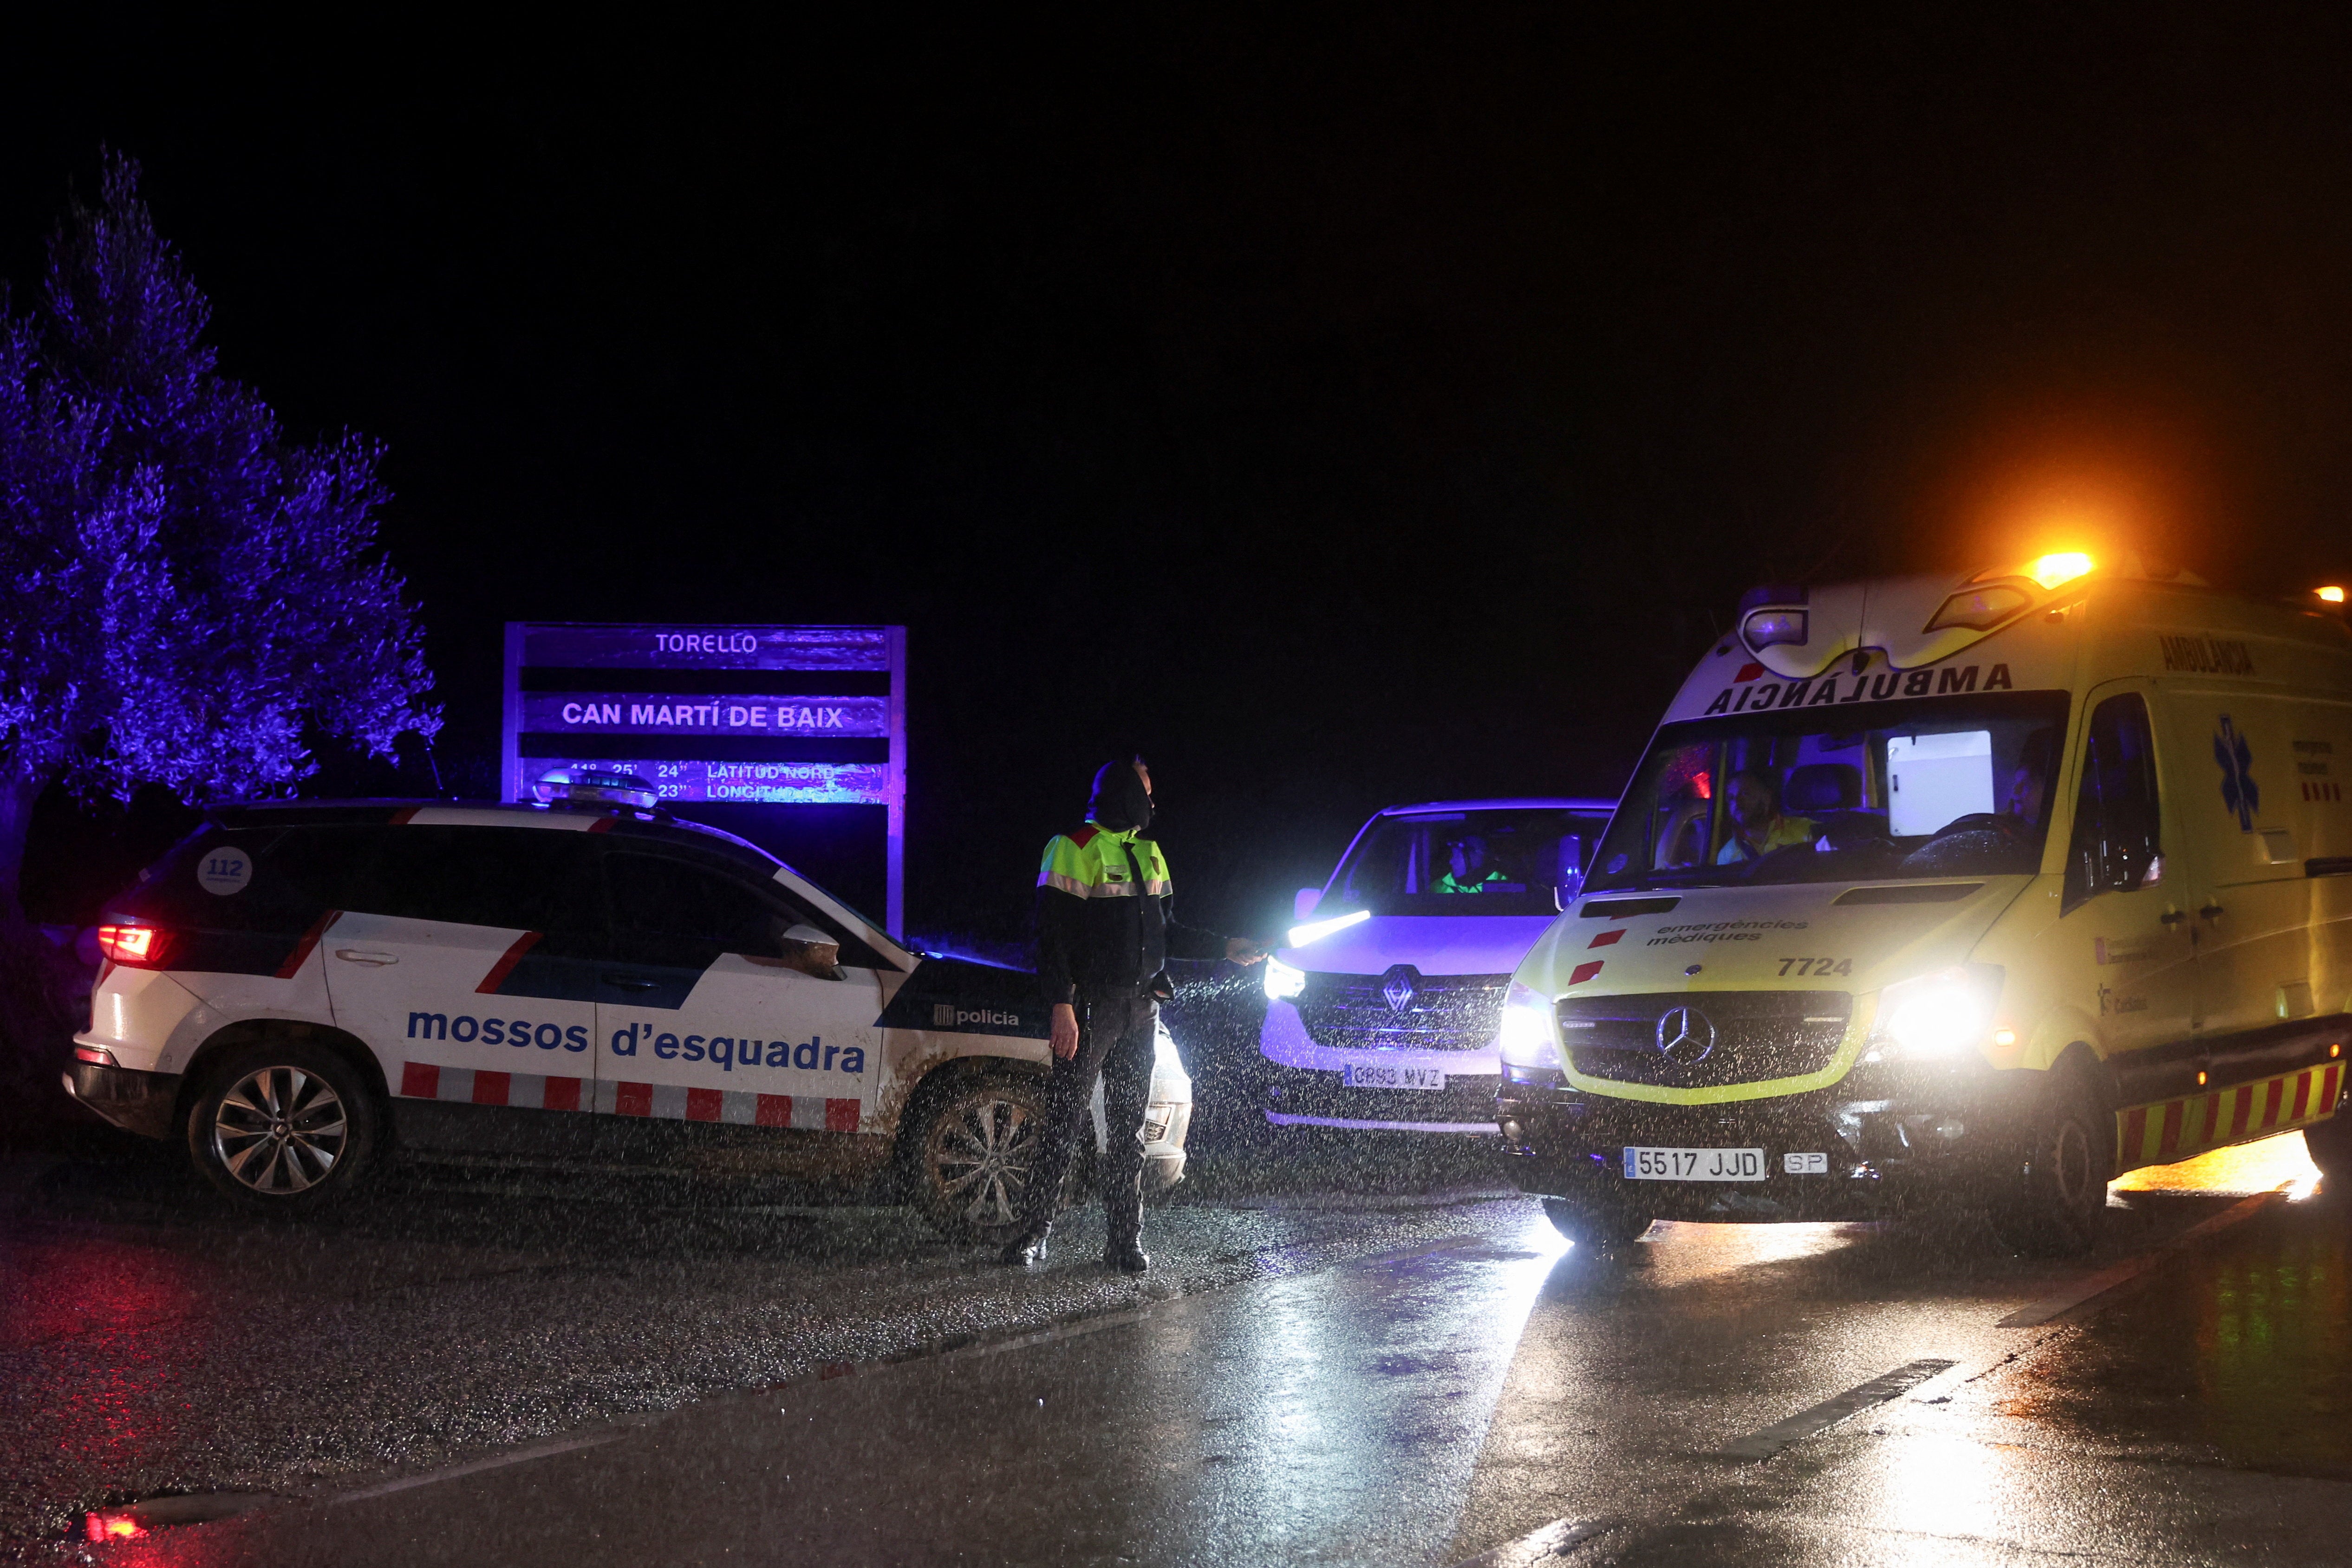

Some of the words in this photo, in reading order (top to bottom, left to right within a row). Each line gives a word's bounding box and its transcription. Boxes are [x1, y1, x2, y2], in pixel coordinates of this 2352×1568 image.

[655, 634, 757, 652] TORELLO
[562, 703, 620, 724] CAN
[631, 700, 718, 726] MARTÍ
[730, 706, 767, 727] DE
[778, 707, 843, 729] BAIX
[707, 765, 779, 780] LATITUD
[785, 766, 835, 780] NORD
[706, 785, 794, 799] LONGITUD
[801, 787, 838, 799] EST
[207, 858, 243, 876] 112
[1657, 919, 1809, 934] emergències
[1647, 931, 1763, 946] mèdiques
[1778, 958, 1853, 976] 7724
[957, 1009, 1019, 1026] policia
[407, 1011, 588, 1053] mossos
[611, 1022, 865, 1074] d'esquadra
[1639, 1152, 1697, 1176] 5517
[1709, 1152, 1758, 1177] JJD
[1788, 1155, 1823, 1171] SP
